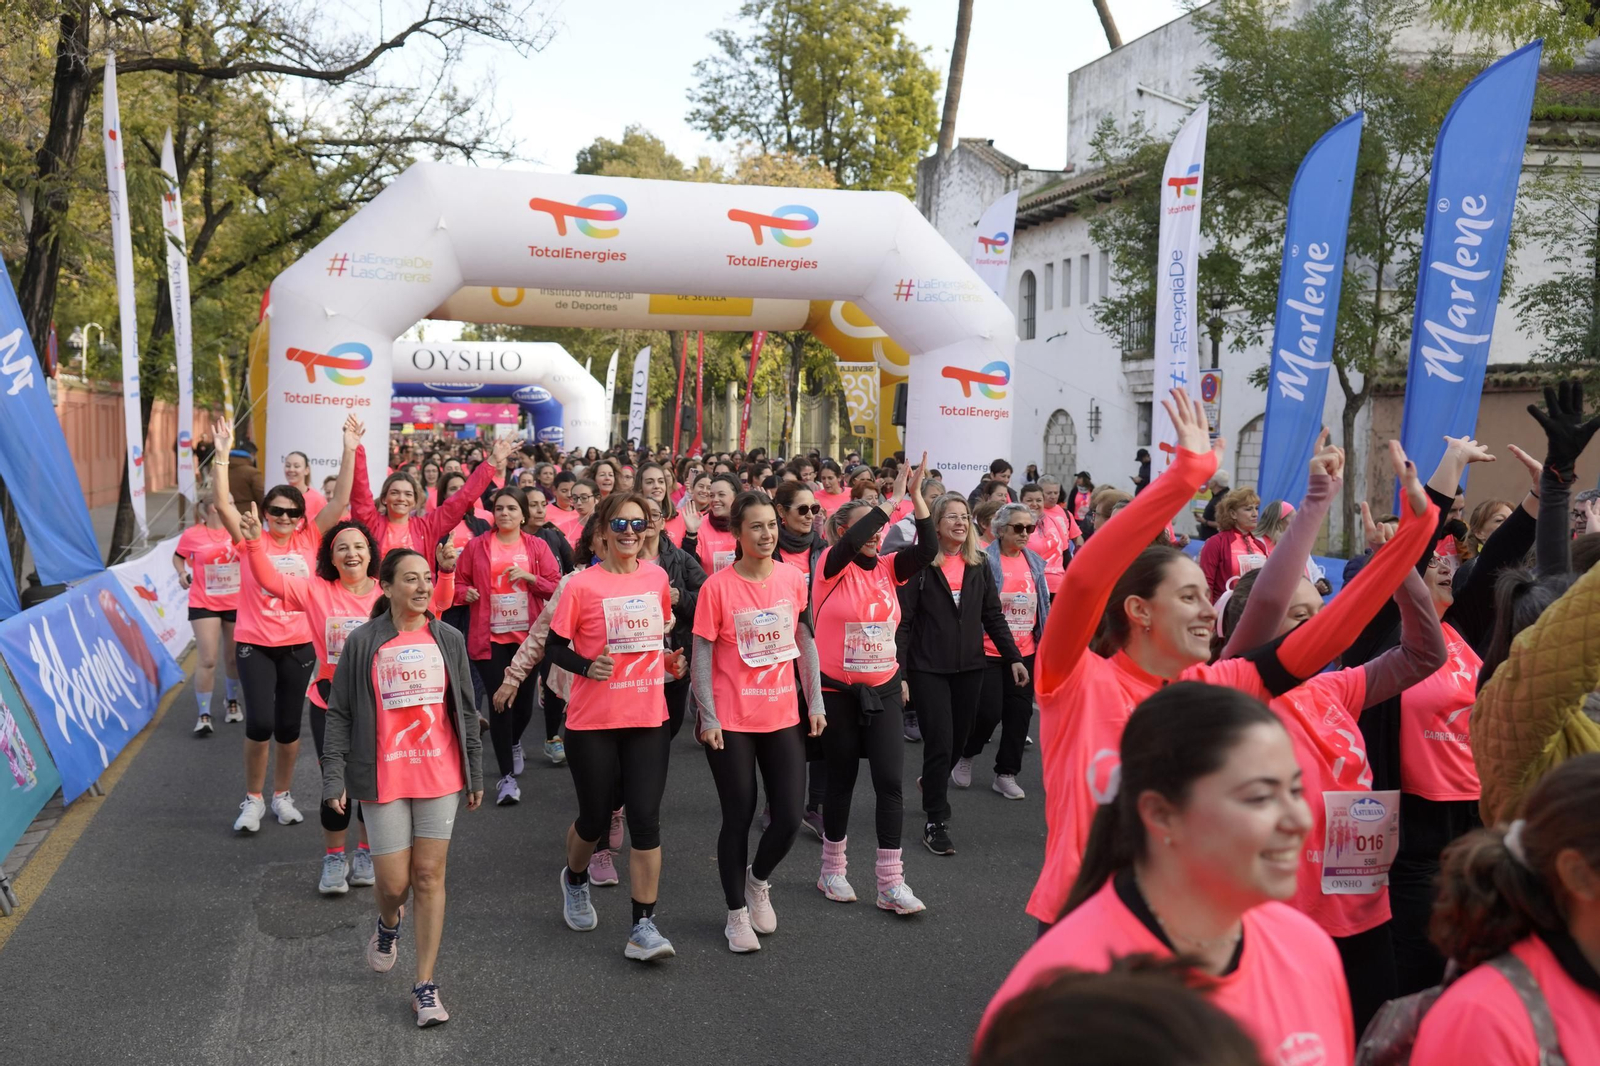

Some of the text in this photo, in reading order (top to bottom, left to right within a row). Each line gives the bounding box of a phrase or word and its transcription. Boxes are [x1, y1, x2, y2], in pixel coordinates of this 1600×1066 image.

[528, 245, 627, 263] TotalEnergies
[726, 254, 819, 272] TotalEnergies
[1421, 194, 1495, 383] Marlene
[555, 300, 618, 312] de Deportes
[1277, 241, 1334, 401] Marlene
[412, 348, 522, 373] OYSHO
[283, 391, 371, 408] TotalEnergies
[939, 405, 1010, 421] TotalEnergies
[502, 609, 519, 617] 016
[1011, 608, 1027, 616] 016
[628, 619, 649, 630] 016
[758, 630, 780, 643] 016
[864, 643, 883, 652] 016
[401, 669, 427, 682] 016
[610, 680, 635, 690] CARRERA
[636, 679, 645, 687] DE
[645, 678, 653, 686] LA
[741, 688, 767, 696] CARRERA
[768, 688, 776, 696] DE
[384, 750, 408, 762] CARRERA
[408, 749, 418, 758] DE
[418, 749, 426, 757] LA
[1353, 807, 1384, 816] ASTURIANA
[1356, 834, 1384, 851] 016
[1332, 879, 1362, 888] OYSHO
